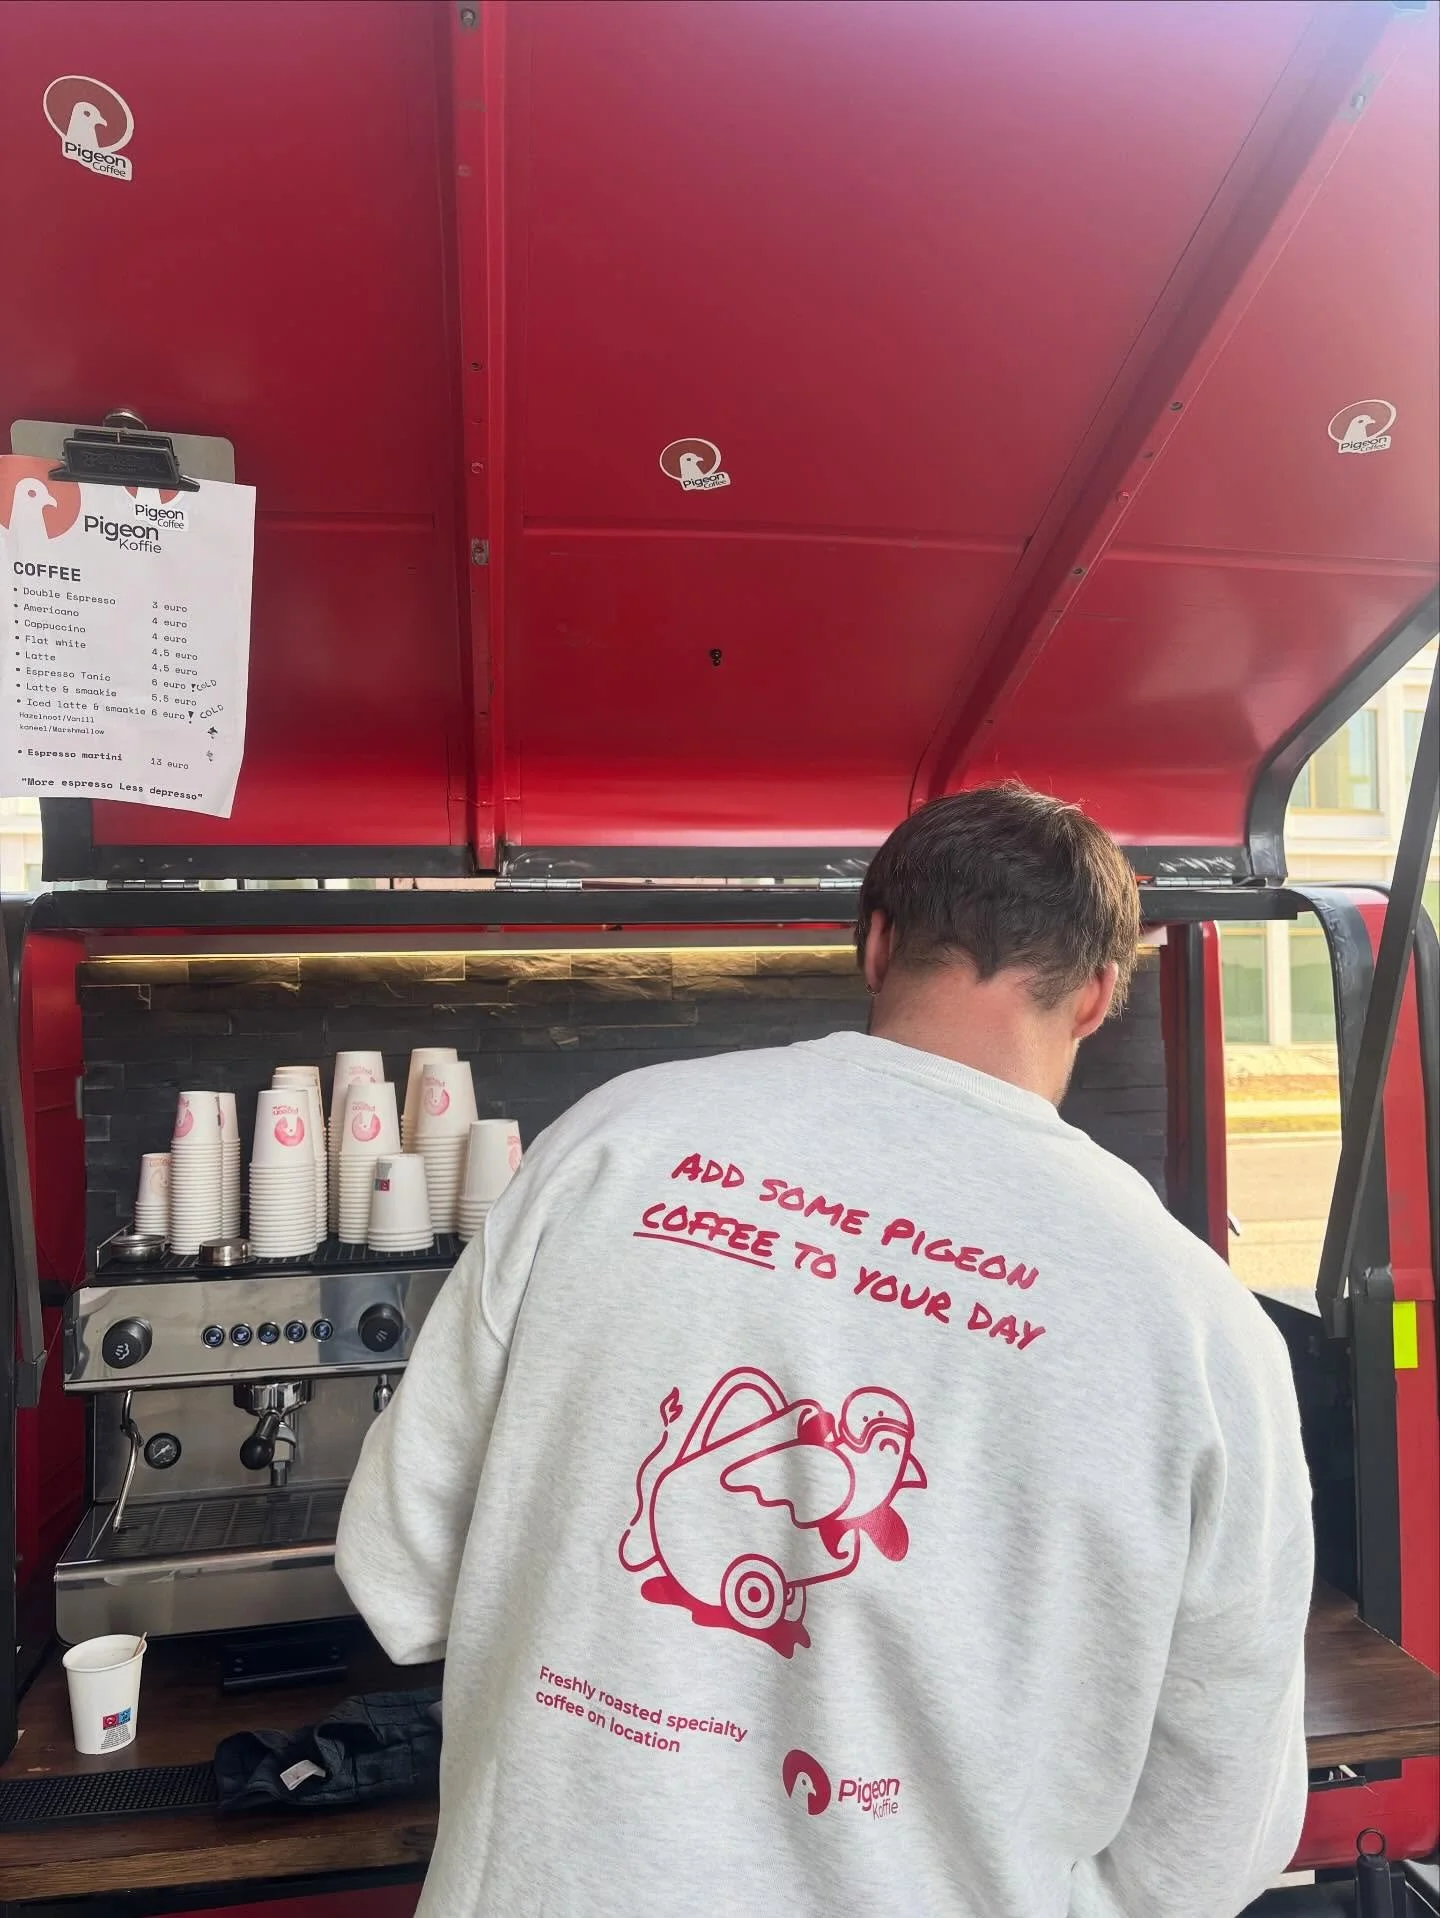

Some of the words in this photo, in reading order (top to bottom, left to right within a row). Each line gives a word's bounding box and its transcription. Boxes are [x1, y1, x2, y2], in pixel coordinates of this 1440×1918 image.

[65, 141, 127, 168] Pigeon
[92, 162, 126, 177] Coffee
[1340, 437, 1387, 451] Pigeon
[682, 473, 725, 488] Pigeon
[135, 503, 184, 523] Pigeon
[157, 518, 185, 529] Coffee
[84, 515, 159, 542] Pigeon
[119, 538, 162, 554] Koffie
[13, 561, 81, 582] COFFEE
[23, 587, 61, 599] Double
[66, 592, 116, 605] Espresso
[152, 601, 158, 609] 3
[163, 604, 188, 613] euro
[23, 603, 80, 617] Americano
[151, 617, 158, 626] 4
[163, 621, 188, 629] euro
[24, 619, 86, 633] Cappuccino
[151, 633, 158, 641] 4
[163, 636, 187, 644] euro
[25, 634, 48, 645] Flat
[55, 639, 86, 649] white
[175, 652, 198, 661] euro
[25, 650, 56, 661] Latte
[174, 667, 198, 676] euro
[26, 666, 75, 678] Espresso
[81, 671, 111, 682] Tonic
[151, 678, 158, 687] 6
[163, 681, 186, 690] euro
[26, 682, 57, 692] Latte
[62, 685, 69, 694] &
[75, 687, 117, 697] smaakie
[174, 698, 197, 706] euro
[27, 698, 51, 708] Iced
[57, 700, 88, 710] latte
[93, 703, 99, 711] &
[105, 705, 146, 716] smaakie
[151, 708, 158, 716] 6
[162, 711, 185, 720] euro
[27, 748, 76, 759] Espresso
[81, 751, 123, 761] martini
[150, 757, 162, 766] 13
[167, 761, 189, 770] euro
[21, 777, 55, 786] "More
[61, 779, 113, 789] espresso
[119, 782, 144, 793] Less
[149, 786, 203, 800] depresso"
[671, 1152, 745, 1188] ADD
[758, 1178, 870, 1236] SOME
[879, 1217, 1040, 1291] PIGEON
[641, 1202, 781, 1258] COFFEE
[794, 1240, 838, 1280] TO
[853, 1265, 952, 1324] YOUR
[966, 1301, 1047, 1350] DAY
[539, 1665, 597, 1700] Freshly
[598, 1690, 663, 1725] roasted
[666, 1712, 749, 1743] specialty
[535, 1690, 585, 1718] coffee
[587, 1708, 606, 1729] on
[609, 1717, 681, 1753] location
[837, 1775, 901, 1812] Pigeon
